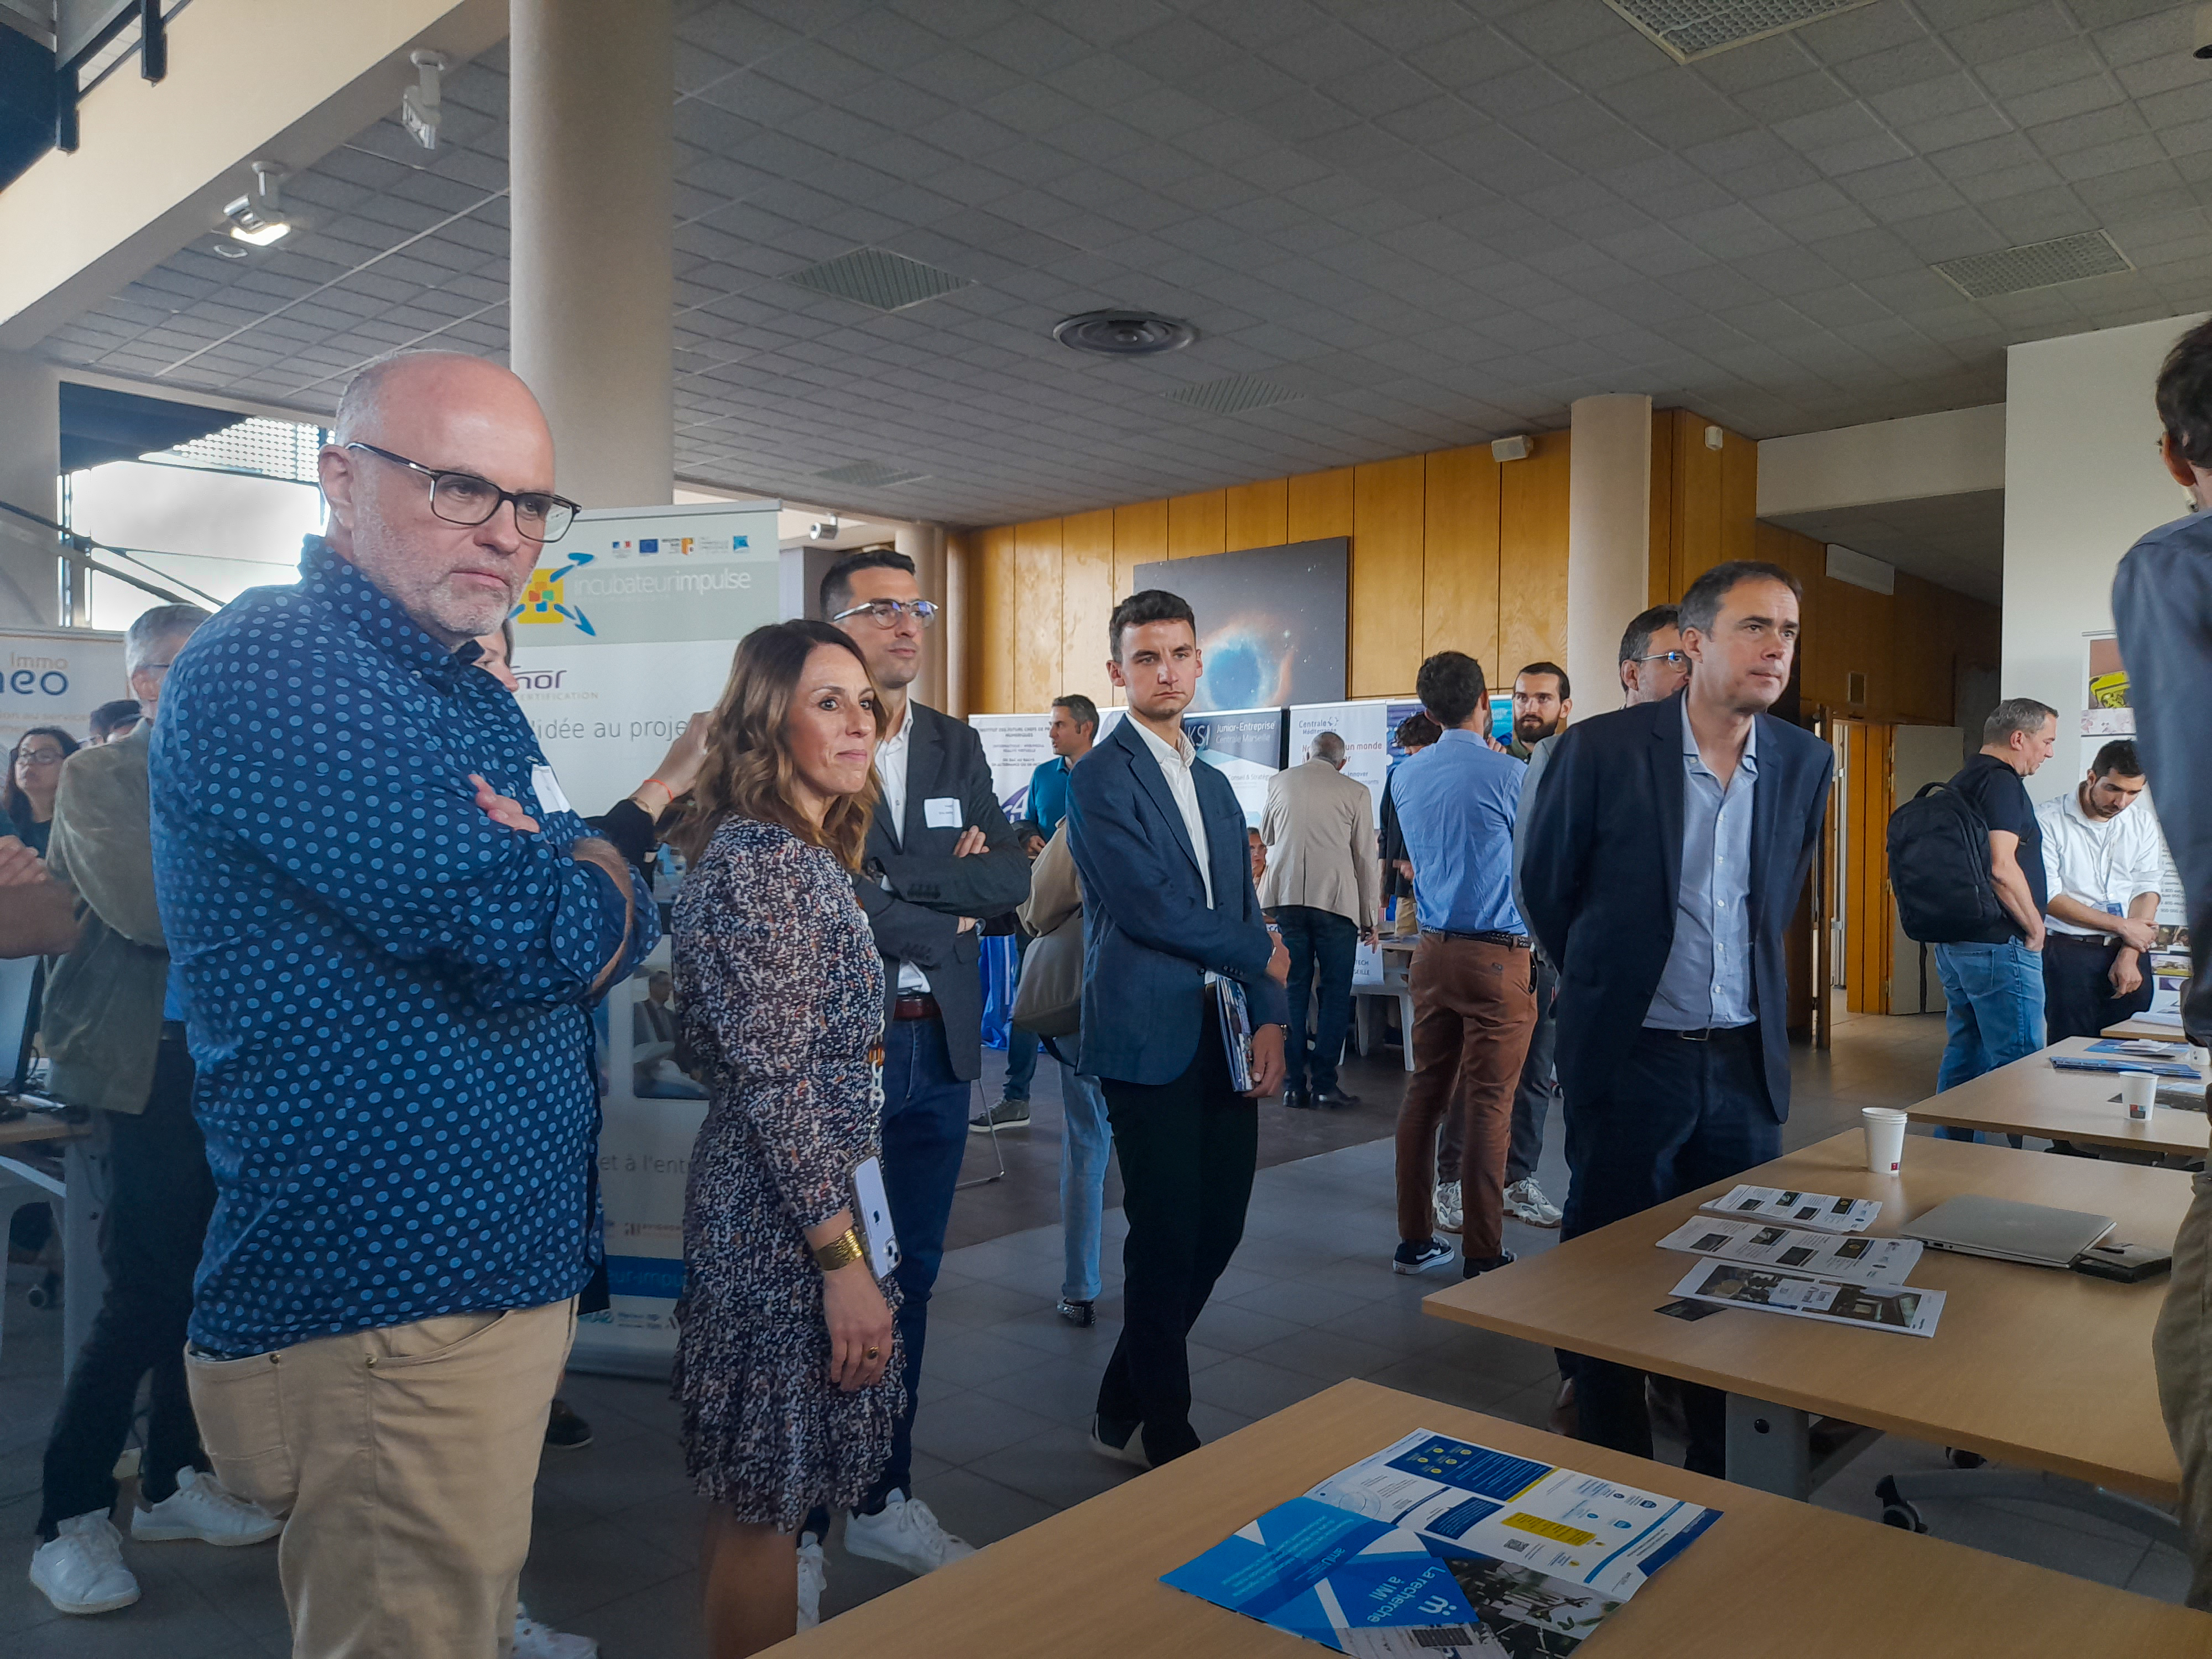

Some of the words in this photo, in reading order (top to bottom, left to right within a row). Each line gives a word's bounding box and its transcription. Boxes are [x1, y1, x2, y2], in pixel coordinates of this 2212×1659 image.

[11, 653, 69, 669] Immo
[593, 723, 621, 738] au
[630, 716, 688, 743] proje
[1298, 719, 1327, 728] Centrale
[1357, 742, 1383, 750] monde
[625, 1154, 636, 1171] à
[643, 1155, 686, 1173] l'ent
[1422, 1566, 1447, 1579] La
[1366, 1578, 1428, 1623] recherche
